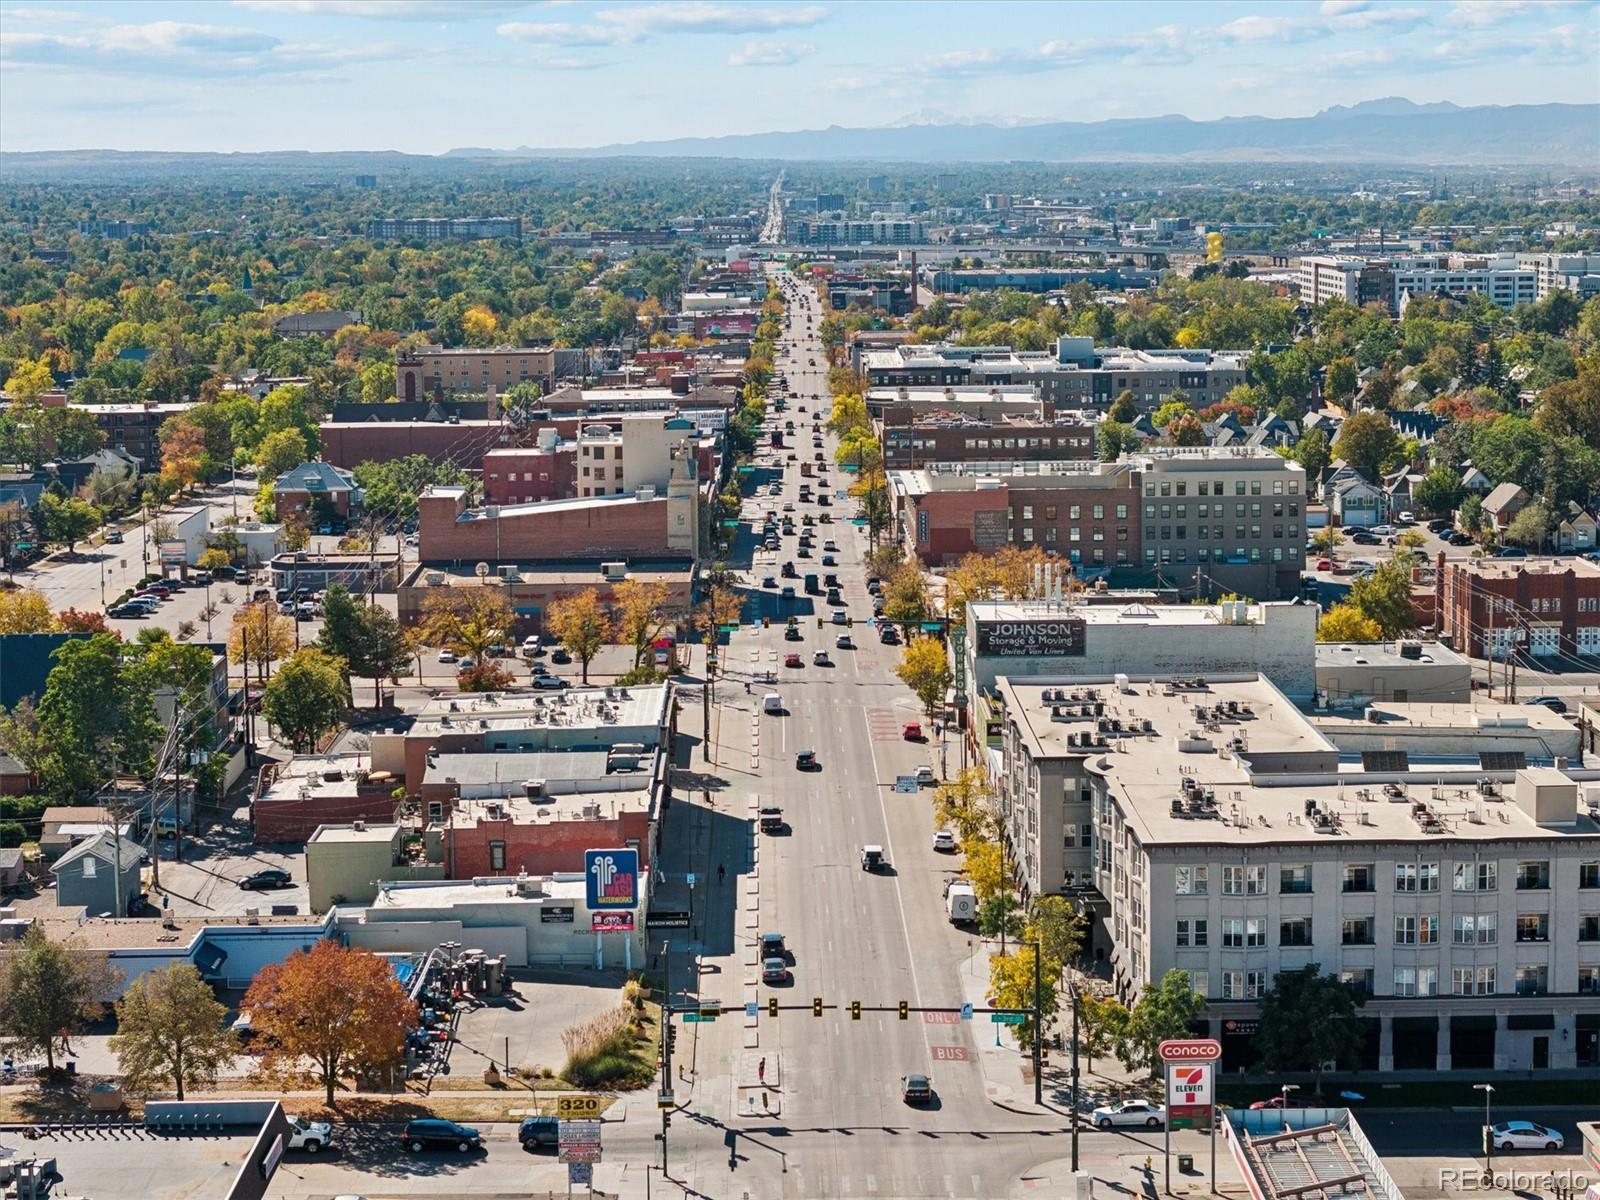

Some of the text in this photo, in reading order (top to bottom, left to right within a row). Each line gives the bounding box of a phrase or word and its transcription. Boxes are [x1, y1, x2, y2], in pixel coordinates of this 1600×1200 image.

[990, 624, 1071, 635] JOHNSON
[988, 636, 1073, 647] Storage & Moving
[956, 637, 965, 698] JOHNSON
[613, 873, 632, 885] CAR
[605, 885, 632, 897] WASH
[937, 1047, 963, 1060] BUS
[560, 1099, 597, 1110] 320
